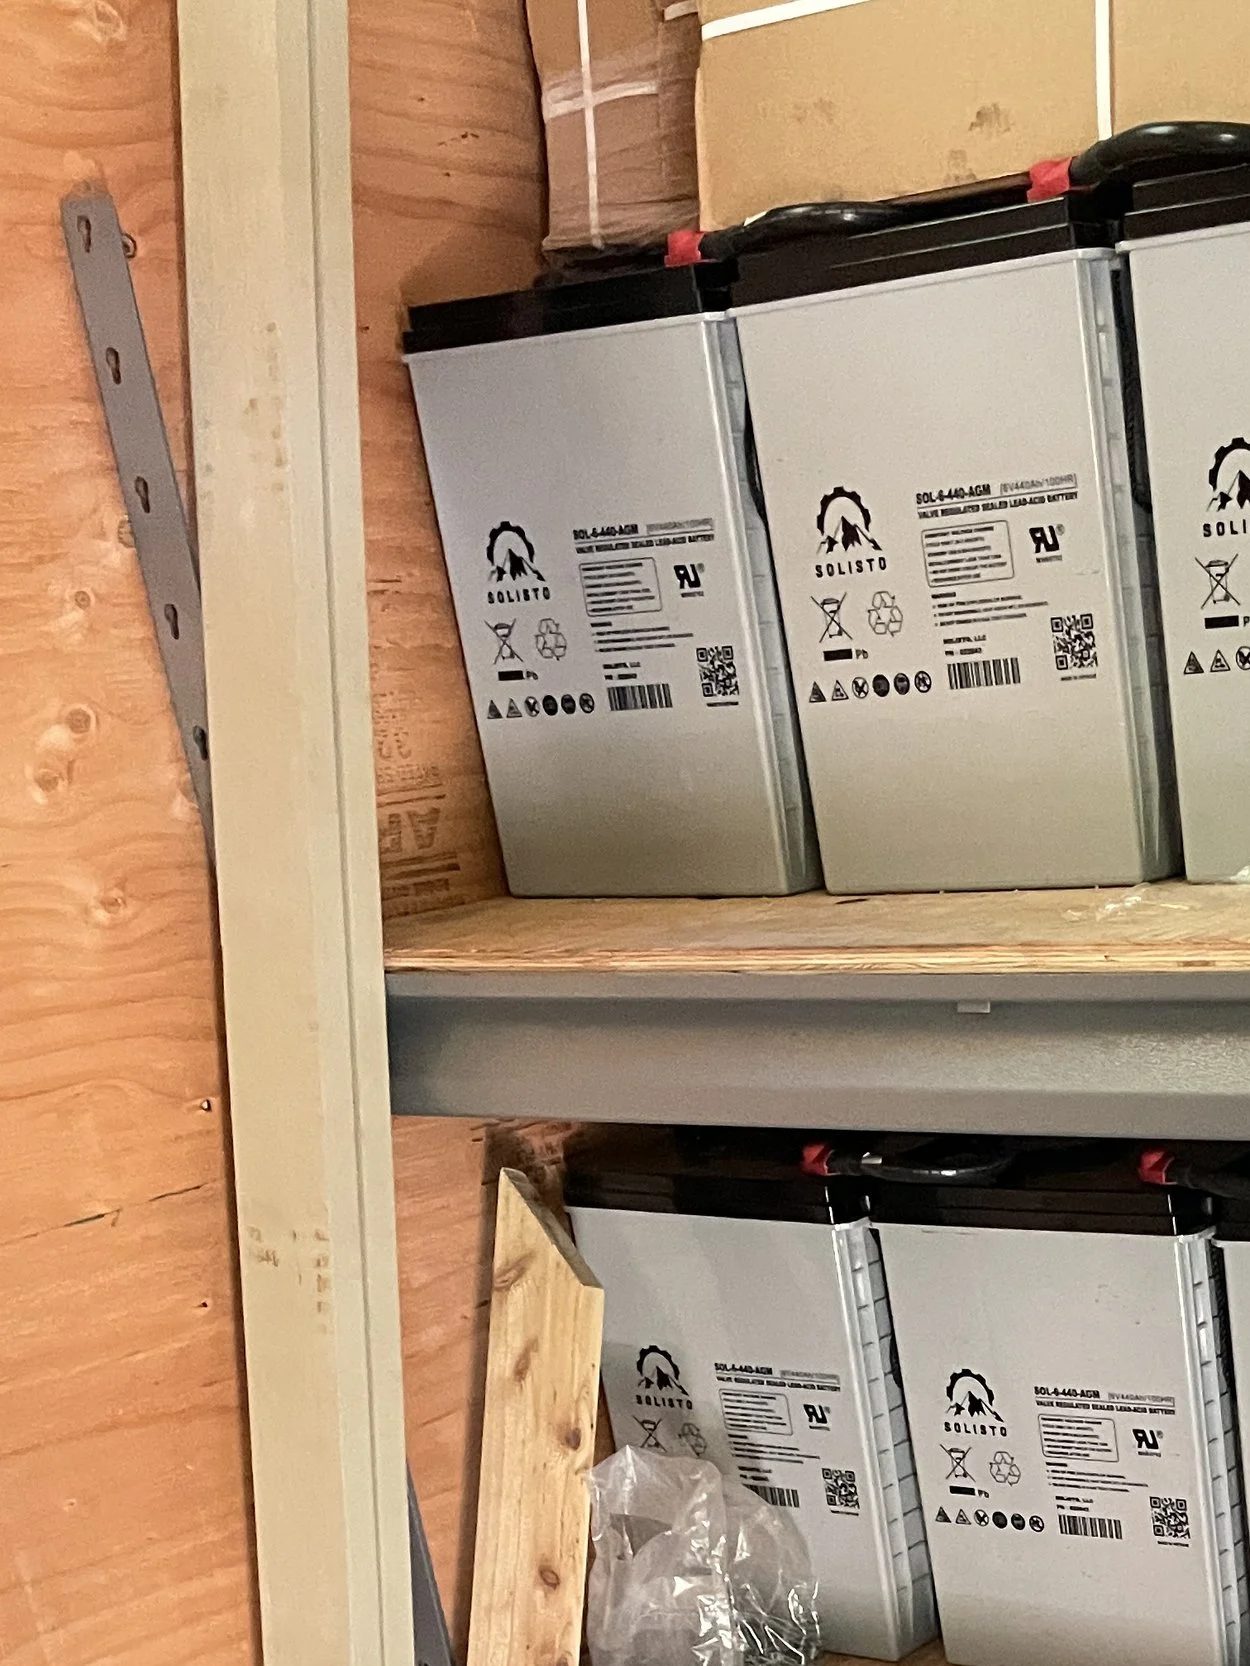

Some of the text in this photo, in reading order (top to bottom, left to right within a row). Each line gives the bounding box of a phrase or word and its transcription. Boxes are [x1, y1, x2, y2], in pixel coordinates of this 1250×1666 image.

[915, 483, 992, 505] SOL-6-440-AGM
[815, 556, 887, 578] SOLISTO
[487, 586, 551, 604] SOLISTO
[635, 1394, 693, 1410] SOLISTO
[944, 1422, 1007, 1437] SOLISTO
